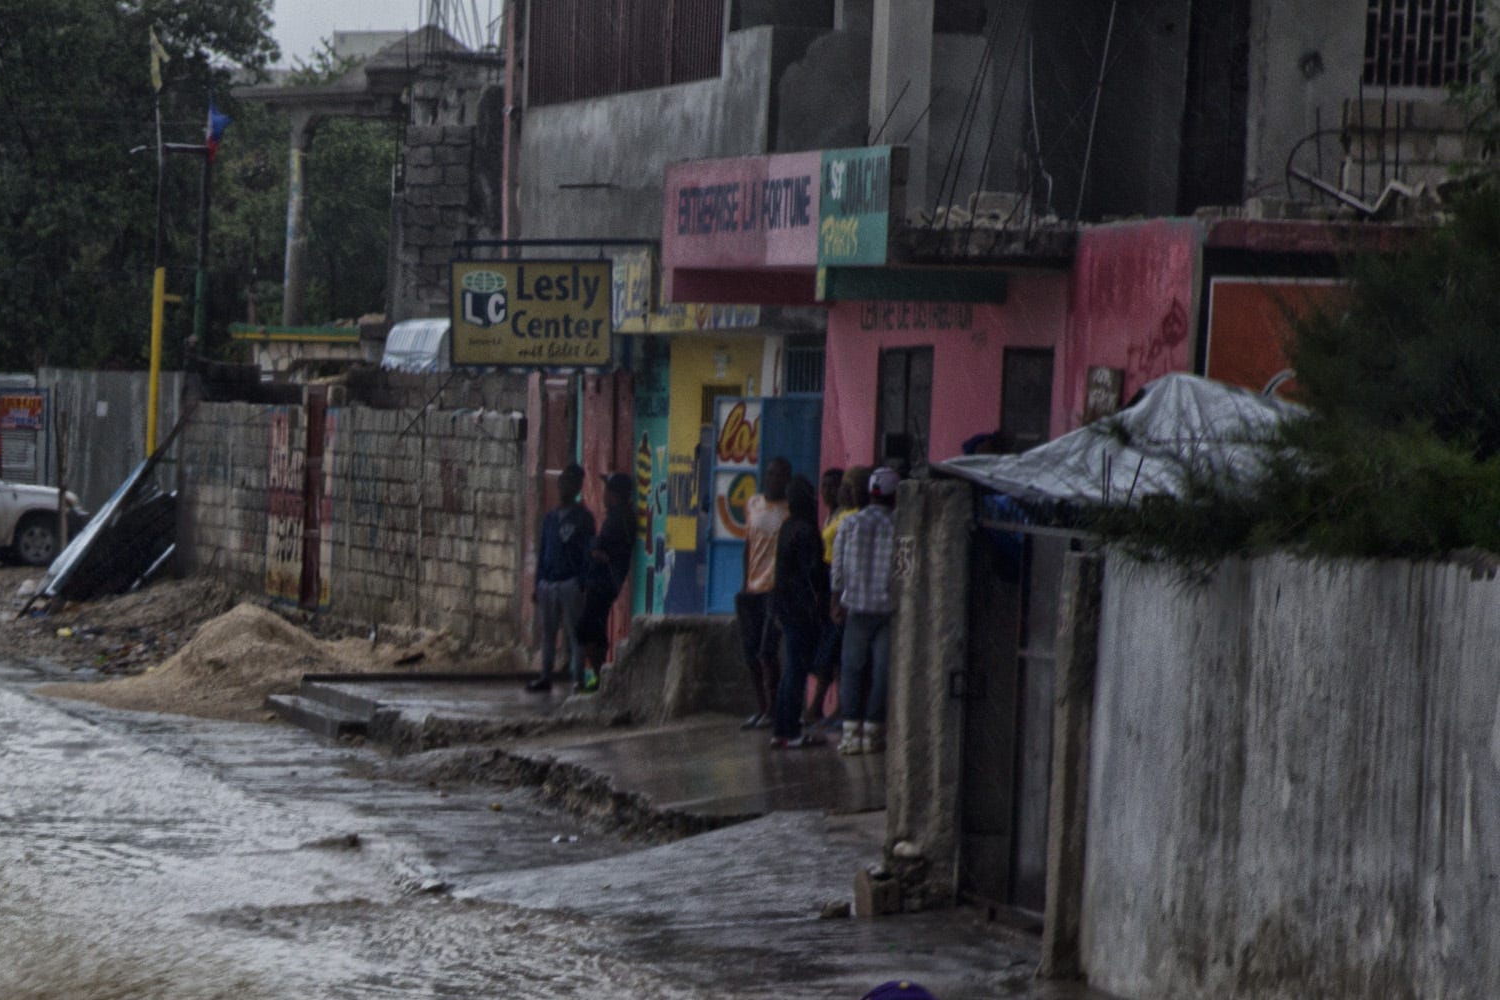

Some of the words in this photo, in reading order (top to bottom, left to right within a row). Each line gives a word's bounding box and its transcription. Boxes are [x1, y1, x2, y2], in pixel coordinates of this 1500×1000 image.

[762, 175, 811, 230] FORTUNE
[517, 265, 600, 310] Lesly
[464, 292, 506, 325] LC
[511, 309, 604, 339] Center
